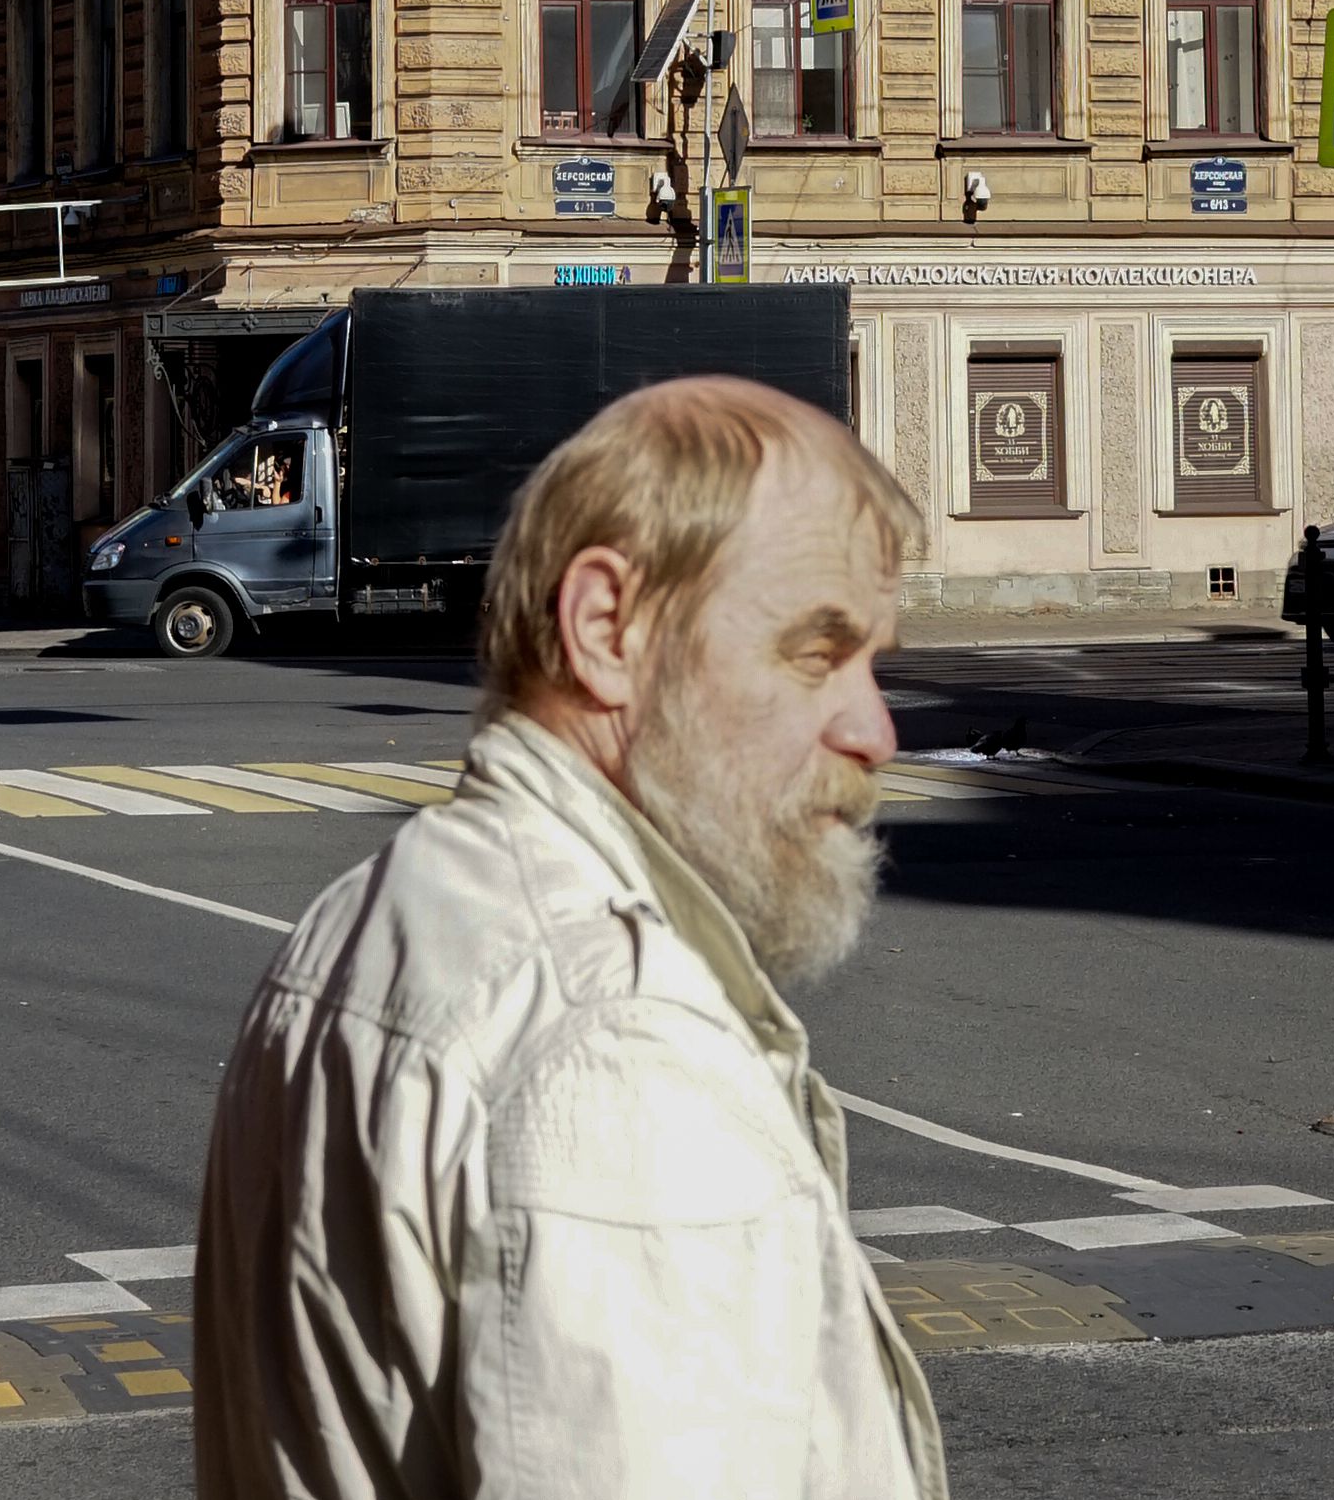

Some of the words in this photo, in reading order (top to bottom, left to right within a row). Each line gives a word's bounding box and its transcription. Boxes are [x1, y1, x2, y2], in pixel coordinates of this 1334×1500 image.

[556, 172, 613, 182] ХЕРСОНСКАЯ
[1194, 171, 1243, 180] ХЕРСОНСКАЯ
[1210, 199, 1229, 210] 6/13
[556, 264, 572, 283] 33
[575, 264, 616, 283] ХОББИ
[784, 265, 859, 283] ЛАВКА
[870, 265, 1058, 285] КЛАДОИСКАТЕЛЯ
[1069, 266, 1258, 286] КОЛЛЕКЦИОНЕРА
[995, 446, 1029, 455] ХОББИ
[1198, 442, 1232, 451] ХОББИ
